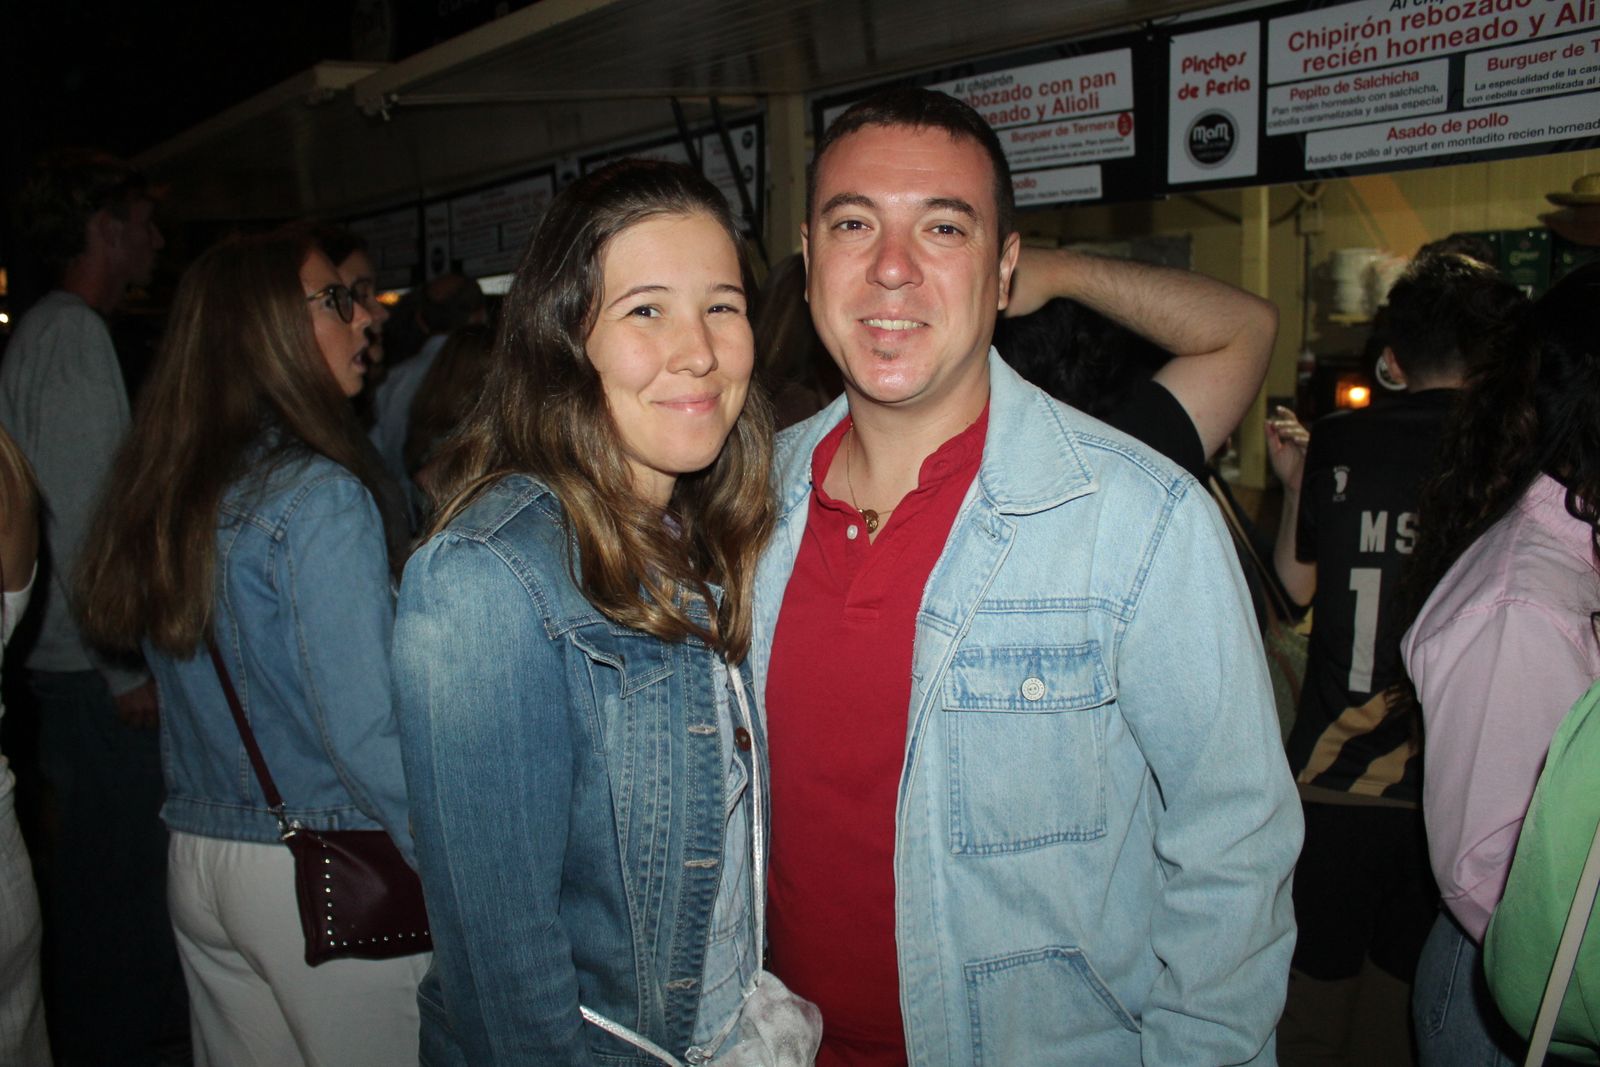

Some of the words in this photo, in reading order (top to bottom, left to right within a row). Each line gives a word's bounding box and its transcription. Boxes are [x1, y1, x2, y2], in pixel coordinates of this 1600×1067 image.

[1288, 15, 1391, 52] Chipirón
[1302, 43, 1377, 73] recién
[1387, 17, 1518, 59] horneado
[1529, 13, 1546, 38] y
[1181, 50, 1247, 75] Pinchos
[1487, 49, 1557, 72] Burguer
[1562, 43, 1585, 58] de
[1038, 79, 1073, 97] con
[1079, 70, 1117, 93] pan
[1177, 82, 1200, 101] de
[1289, 85, 1330, 102] Pepito
[1333, 80, 1350, 95] de
[1353, 69, 1420, 93] Salchicha
[1466, 94, 1484, 104] con
[1485, 88, 1518, 102] cebolla
[1520, 79, 1584, 96] caramelizada
[1586, 76, 1596, 86] al
[1474, 81, 1486, 92] La
[1488, 70, 1549, 90] especialidad
[1552, 69, 1565, 79] de
[1567, 67, 1577, 77] la
[1579, 64, 1600, 75] cas
[1036, 102, 1046, 123] y
[1052, 91, 1100, 116] Alioli
[1321, 94, 1366, 110] horneado
[1368, 92, 1387, 102] con
[1365, 107, 1372, 117] y
[1374, 102, 1399, 114] salsa
[1401, 94, 1444, 110] especial
[1010, 128, 1052, 144] Burguer
[1055, 123, 1069, 137] de
[1073, 119, 1116, 134] Ternera
[1386, 121, 1438, 142] Asado
[1440, 118, 1462, 134] de
[1466, 111, 1509, 131] pollo
[1307, 151, 1339, 165] Asado
[1339, 150, 1353, 161] de
[1355, 147, 1381, 163] pollo
[1383, 145, 1392, 157] al
[1394, 142, 1429, 158] yogurt
[1430, 141, 1445, 151] en
[1447, 132, 1506, 149] montadito
